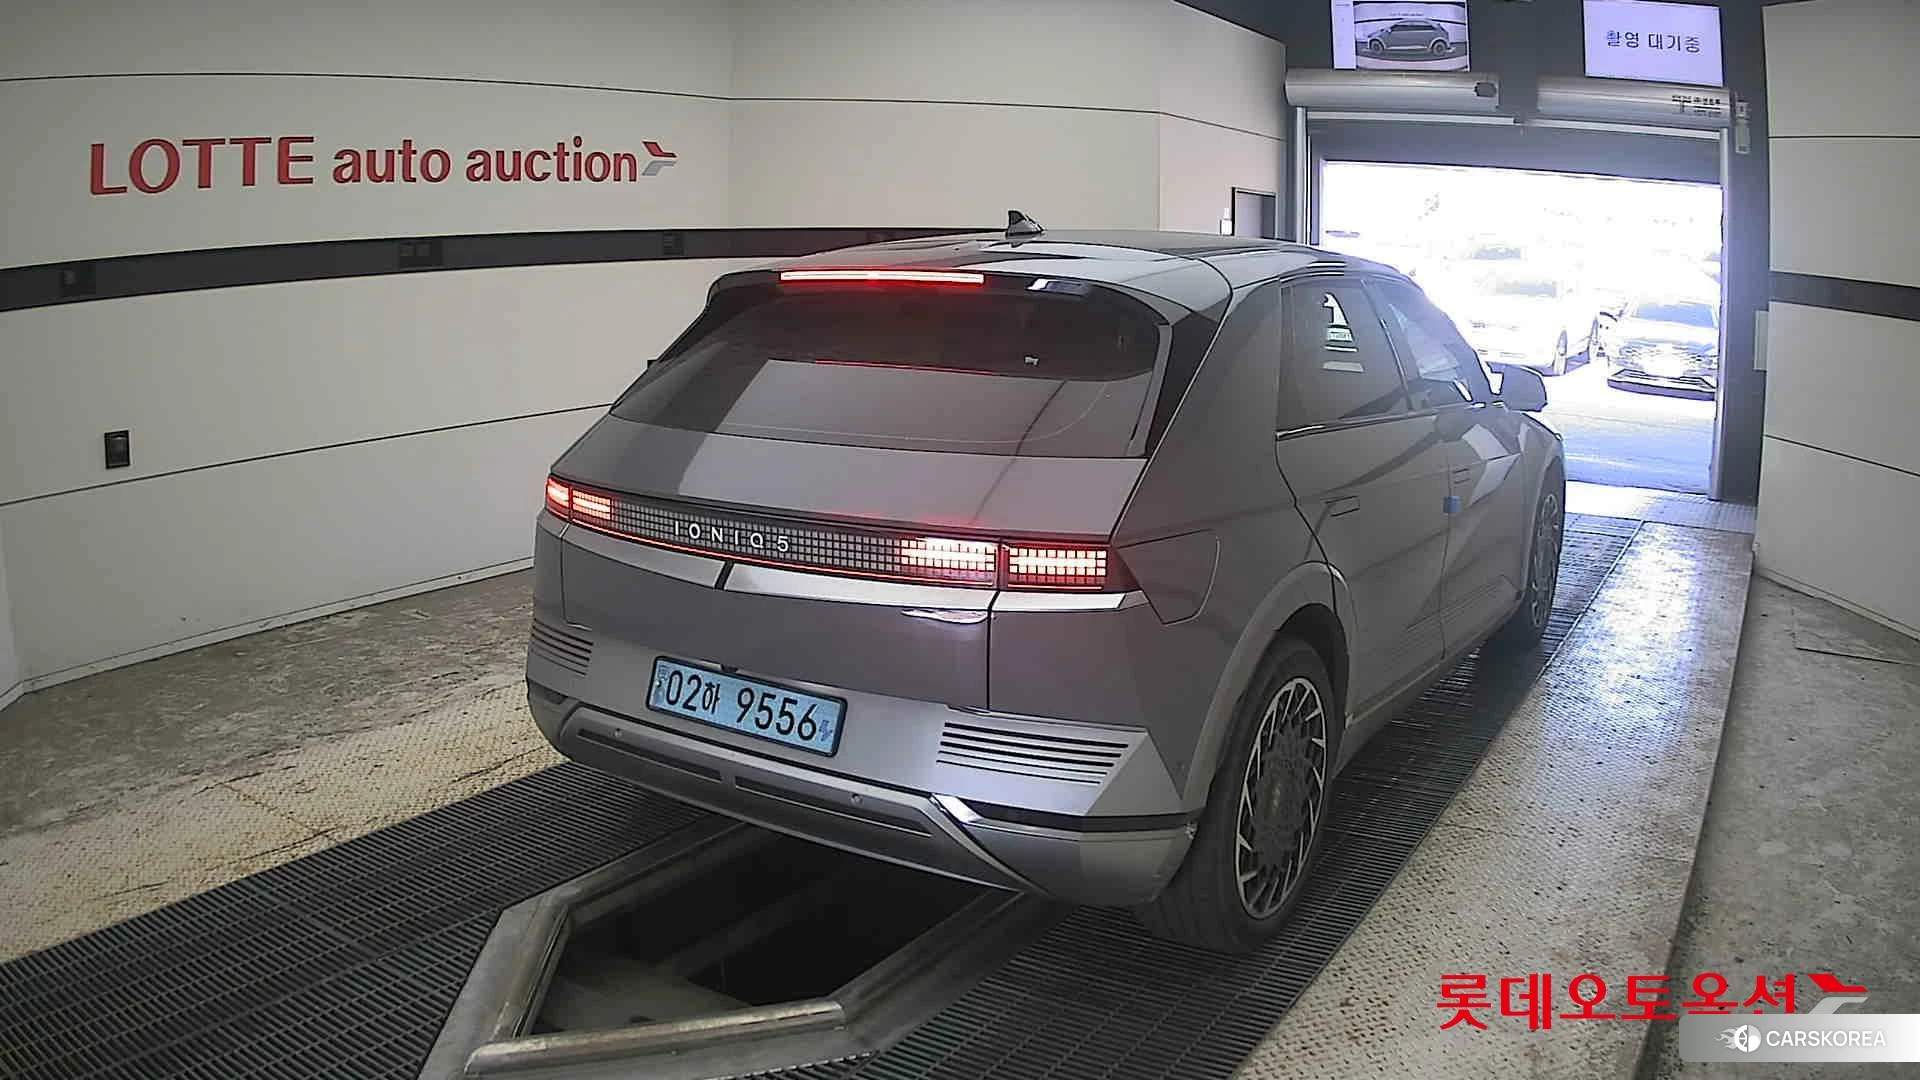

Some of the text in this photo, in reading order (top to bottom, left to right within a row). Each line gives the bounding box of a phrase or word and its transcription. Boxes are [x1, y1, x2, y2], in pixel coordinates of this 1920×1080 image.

[1648, 32, 1700, 53] 대기중
[90, 135, 639, 195] LOTTE auto auction
[674, 520, 790, 552] IONIQ 5
[666, 670, 818, 741] 02하 9556
